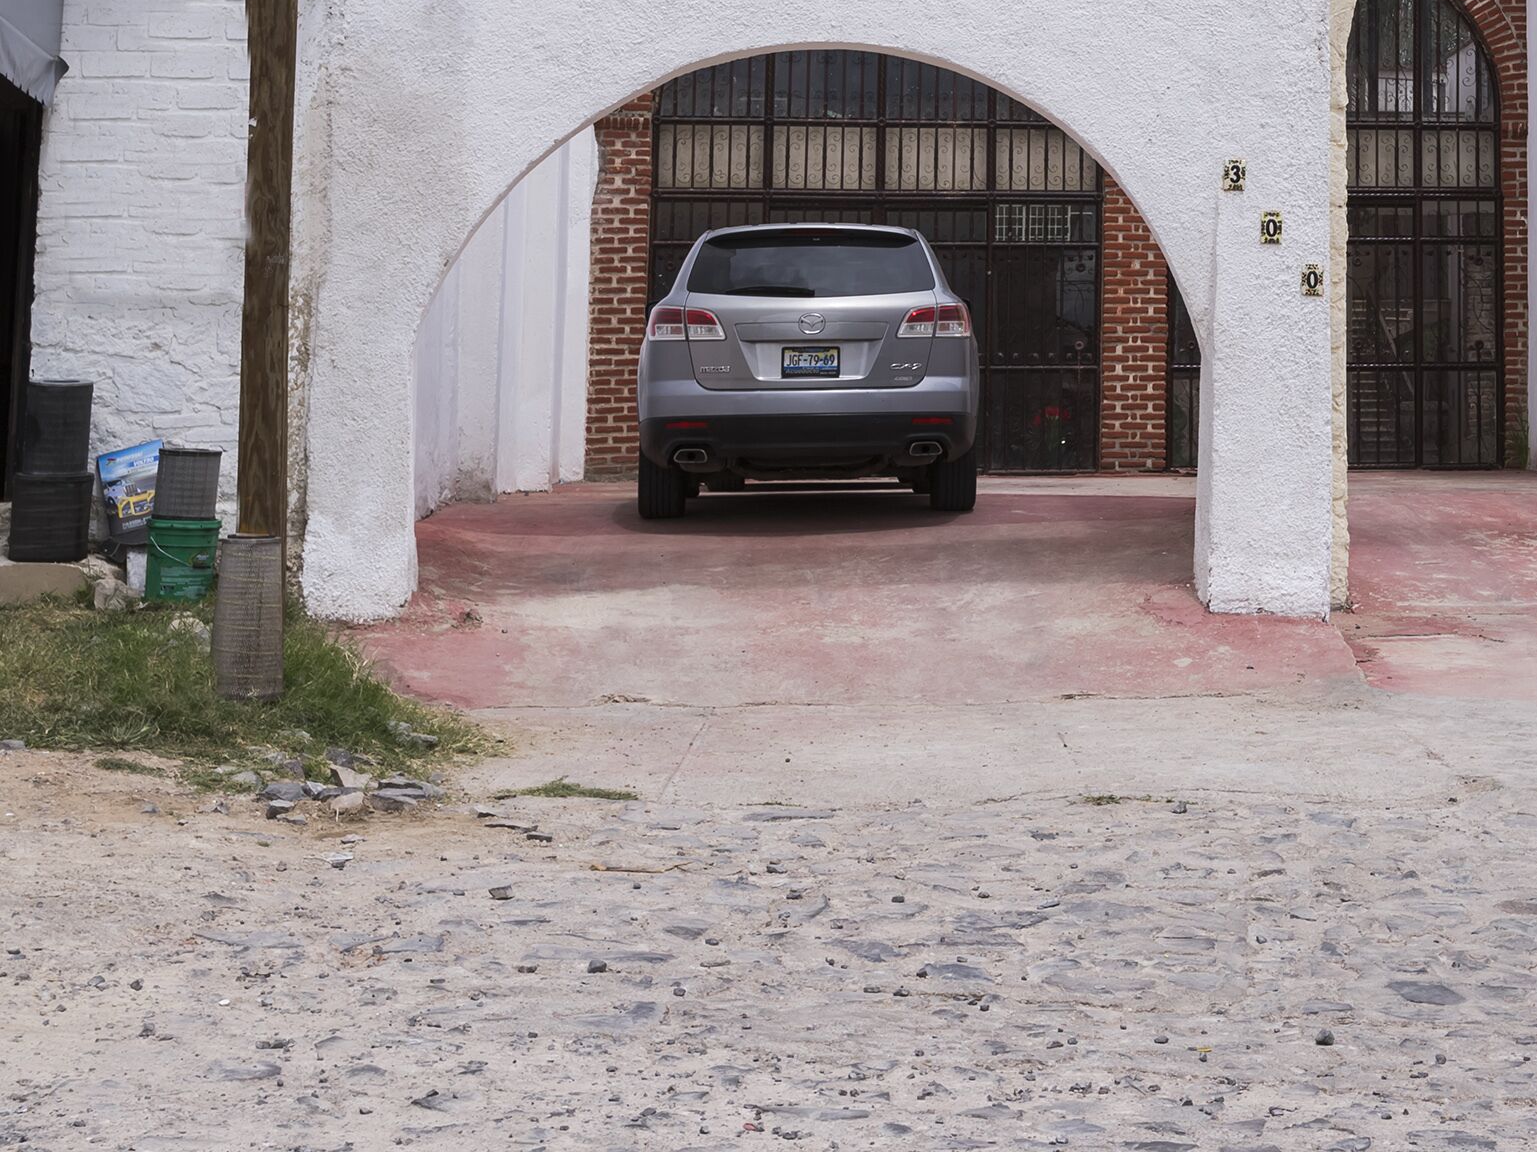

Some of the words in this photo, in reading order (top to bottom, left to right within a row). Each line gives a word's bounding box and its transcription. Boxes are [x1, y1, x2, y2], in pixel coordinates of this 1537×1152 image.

[1229, 164, 1241, 184] 3
[1265, 218, 1278, 238] 0
[1306, 270, 1319, 289] 0
